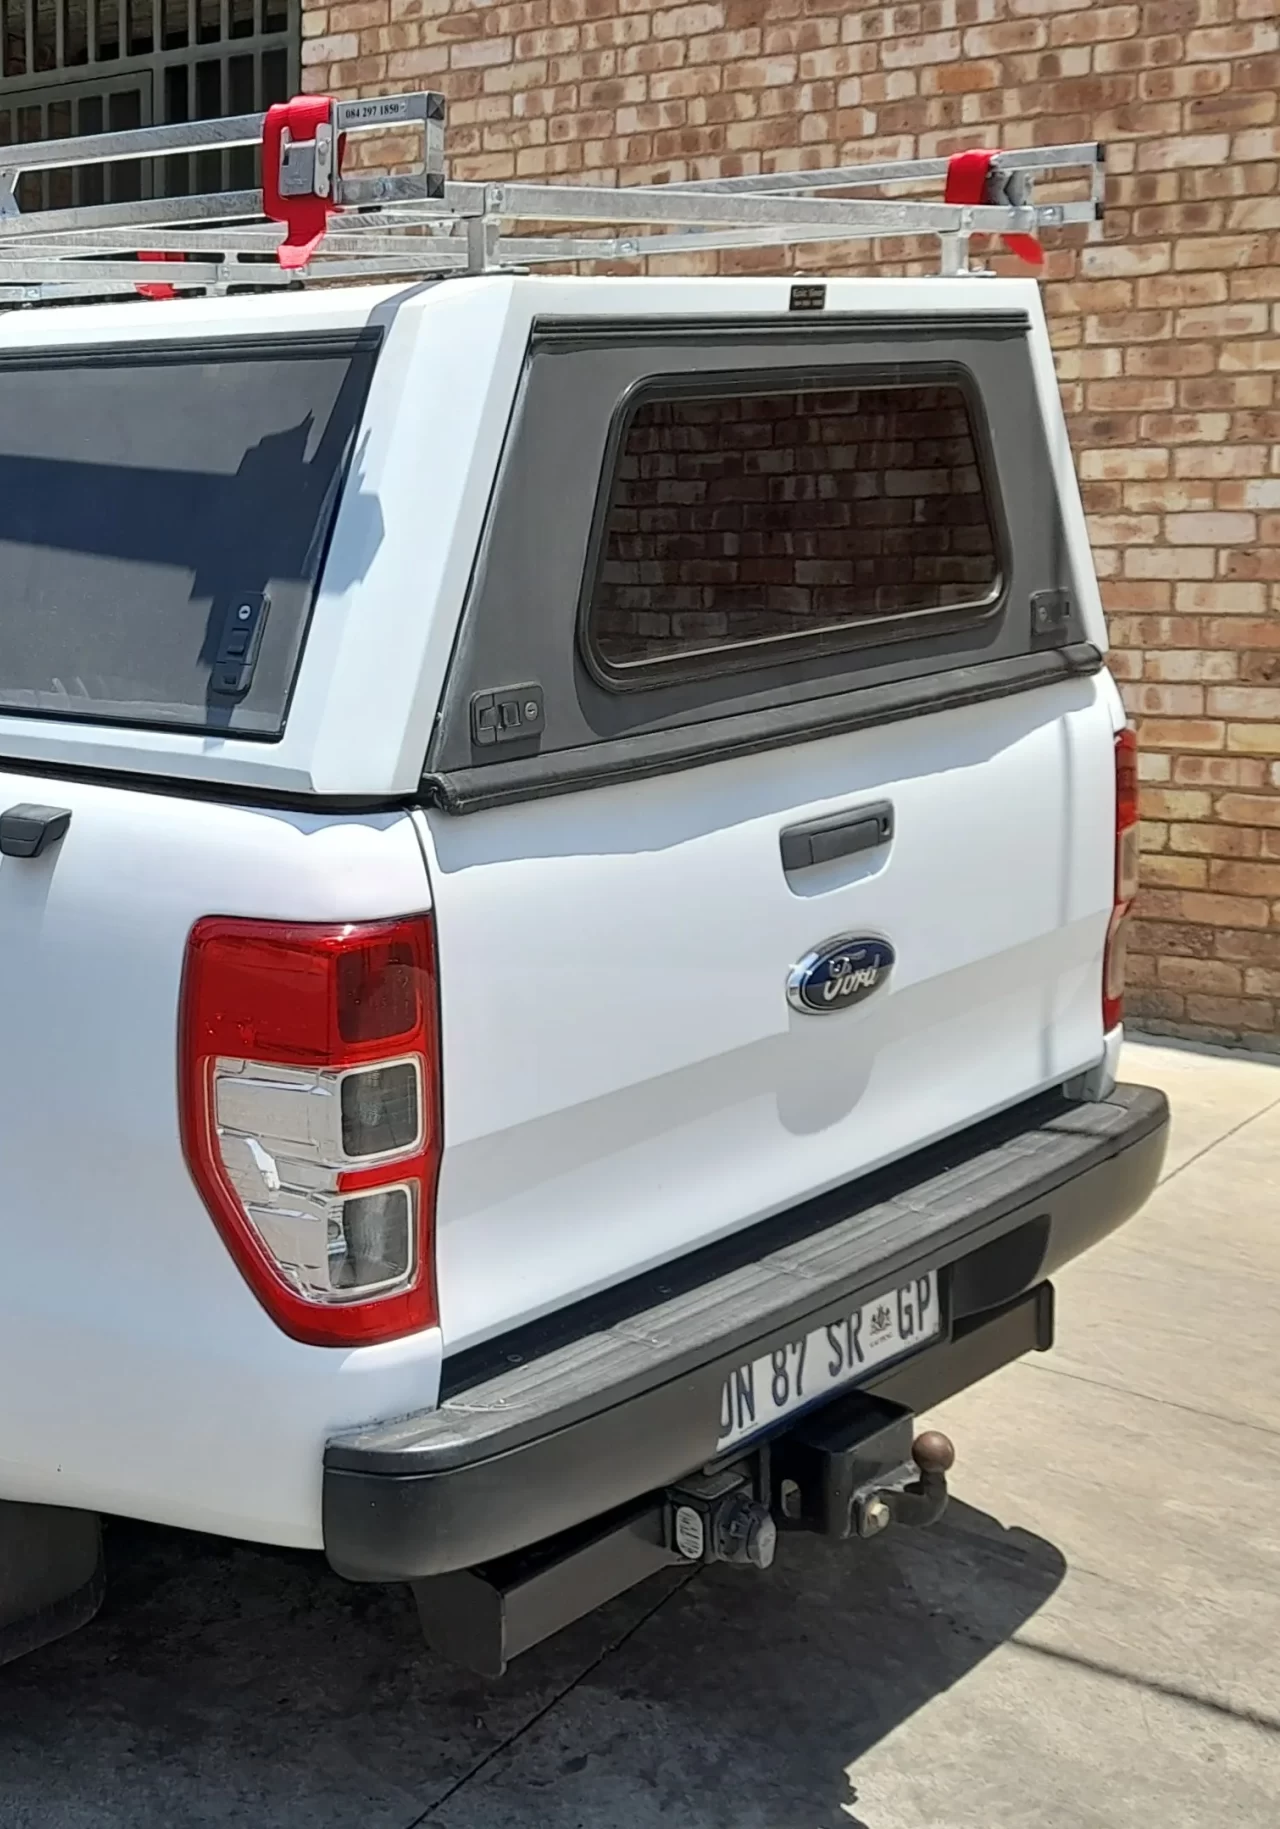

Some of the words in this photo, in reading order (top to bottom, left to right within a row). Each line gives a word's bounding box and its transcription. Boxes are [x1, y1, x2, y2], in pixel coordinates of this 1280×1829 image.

[345, 108, 360, 119] 084
[362, 106, 377, 118] 297
[379, 104, 399, 116] 1850
[823, 948, 880, 1001] Ford
[771, 1332, 809, 1408] 87
[824, 1305, 866, 1378] SR
[896, 1270, 932, 1341] GP
